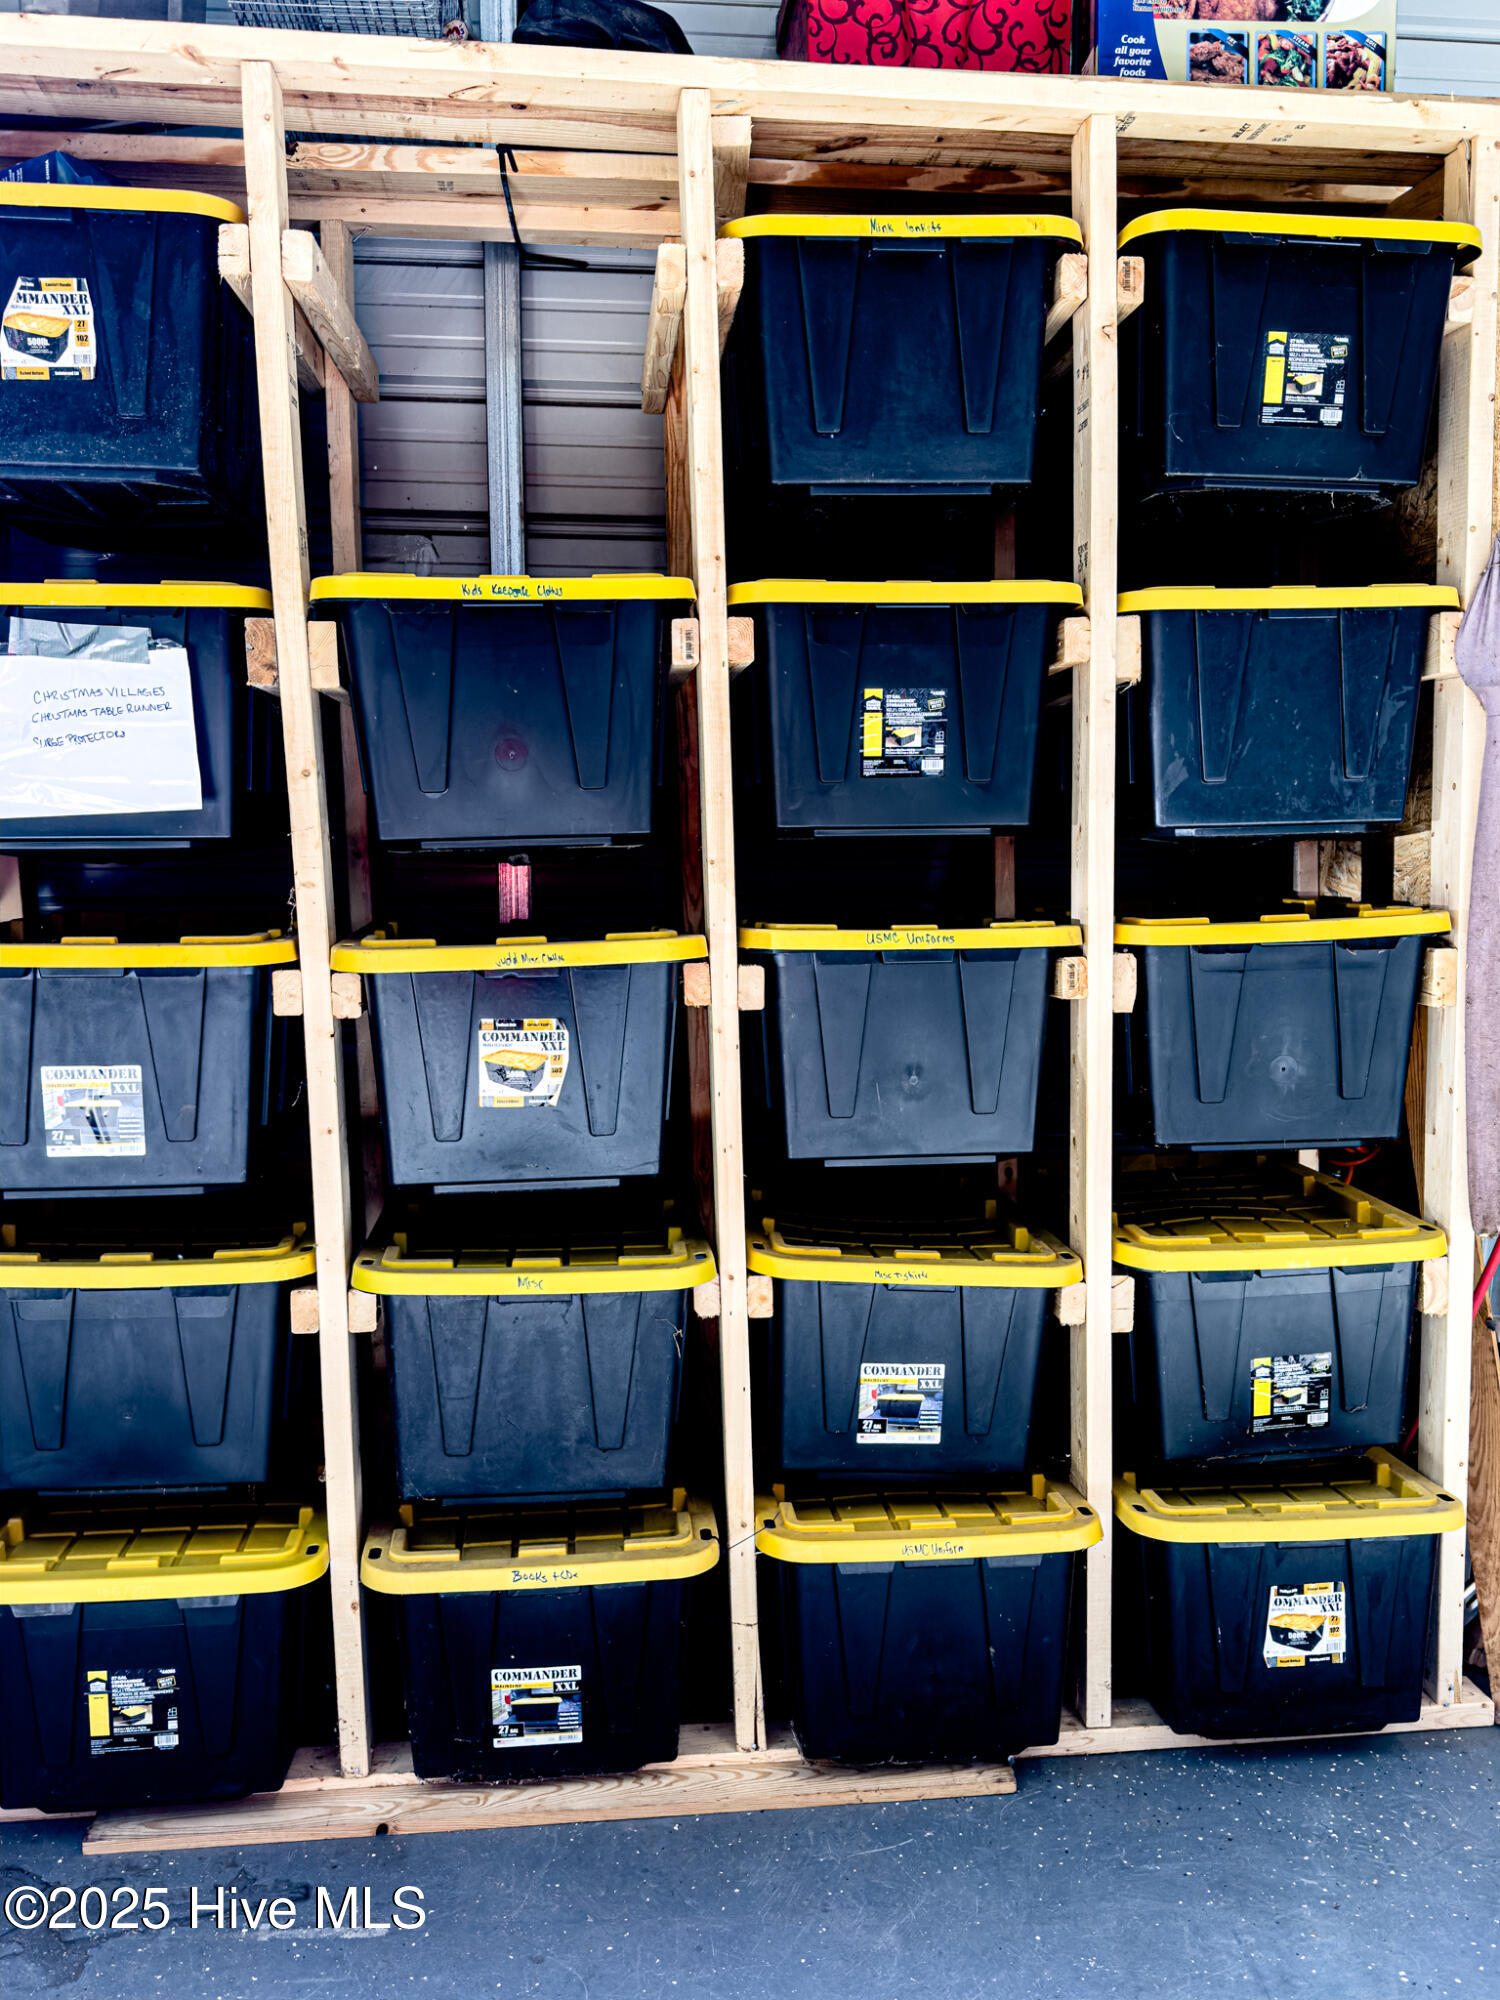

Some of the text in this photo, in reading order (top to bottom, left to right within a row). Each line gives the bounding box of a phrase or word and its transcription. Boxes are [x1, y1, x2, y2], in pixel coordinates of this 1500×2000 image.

[1121, 34, 1146, 44] Cook
[1292, 35, 1310, 49] STEAM
[1115, 46, 1152, 57] all your
[1113, 56, 1152, 67] favorite
[1120, 67, 1146, 77] foods
[63, 304, 90, 315] XXL
[77, 320, 85, 328] 27
[76, 334, 88, 342] 102
[462, 584, 482, 596] Kids
[33, 686, 166, 704] CHRISTMAS VILLAGES
[31, 702, 172, 723] CHRISTMAS TABLE RUNNER
[32, 736, 64, 748] SURGE
[866, 932, 955, 944] USMC Uniforms
[482, 1031, 566, 1042] COMMANDER
[541, 1042, 566, 1051] XXL
[45, 1068, 138, 1080] COMMANDER
[112, 1083, 140, 1094] XXL
[52, 1130, 64, 1141] 27
[864, 1366, 941, 1376] COMMANDER
[920, 1380, 942, 1389] XXL
[862, 1420, 873, 1429] 27
[1320, 1603, 1342, 1613] XXL
[494, 1668, 578, 1681] COMMANDER
[555, 1681, 579, 1692] XXL
[498, 1725, 509, 1734] 27
